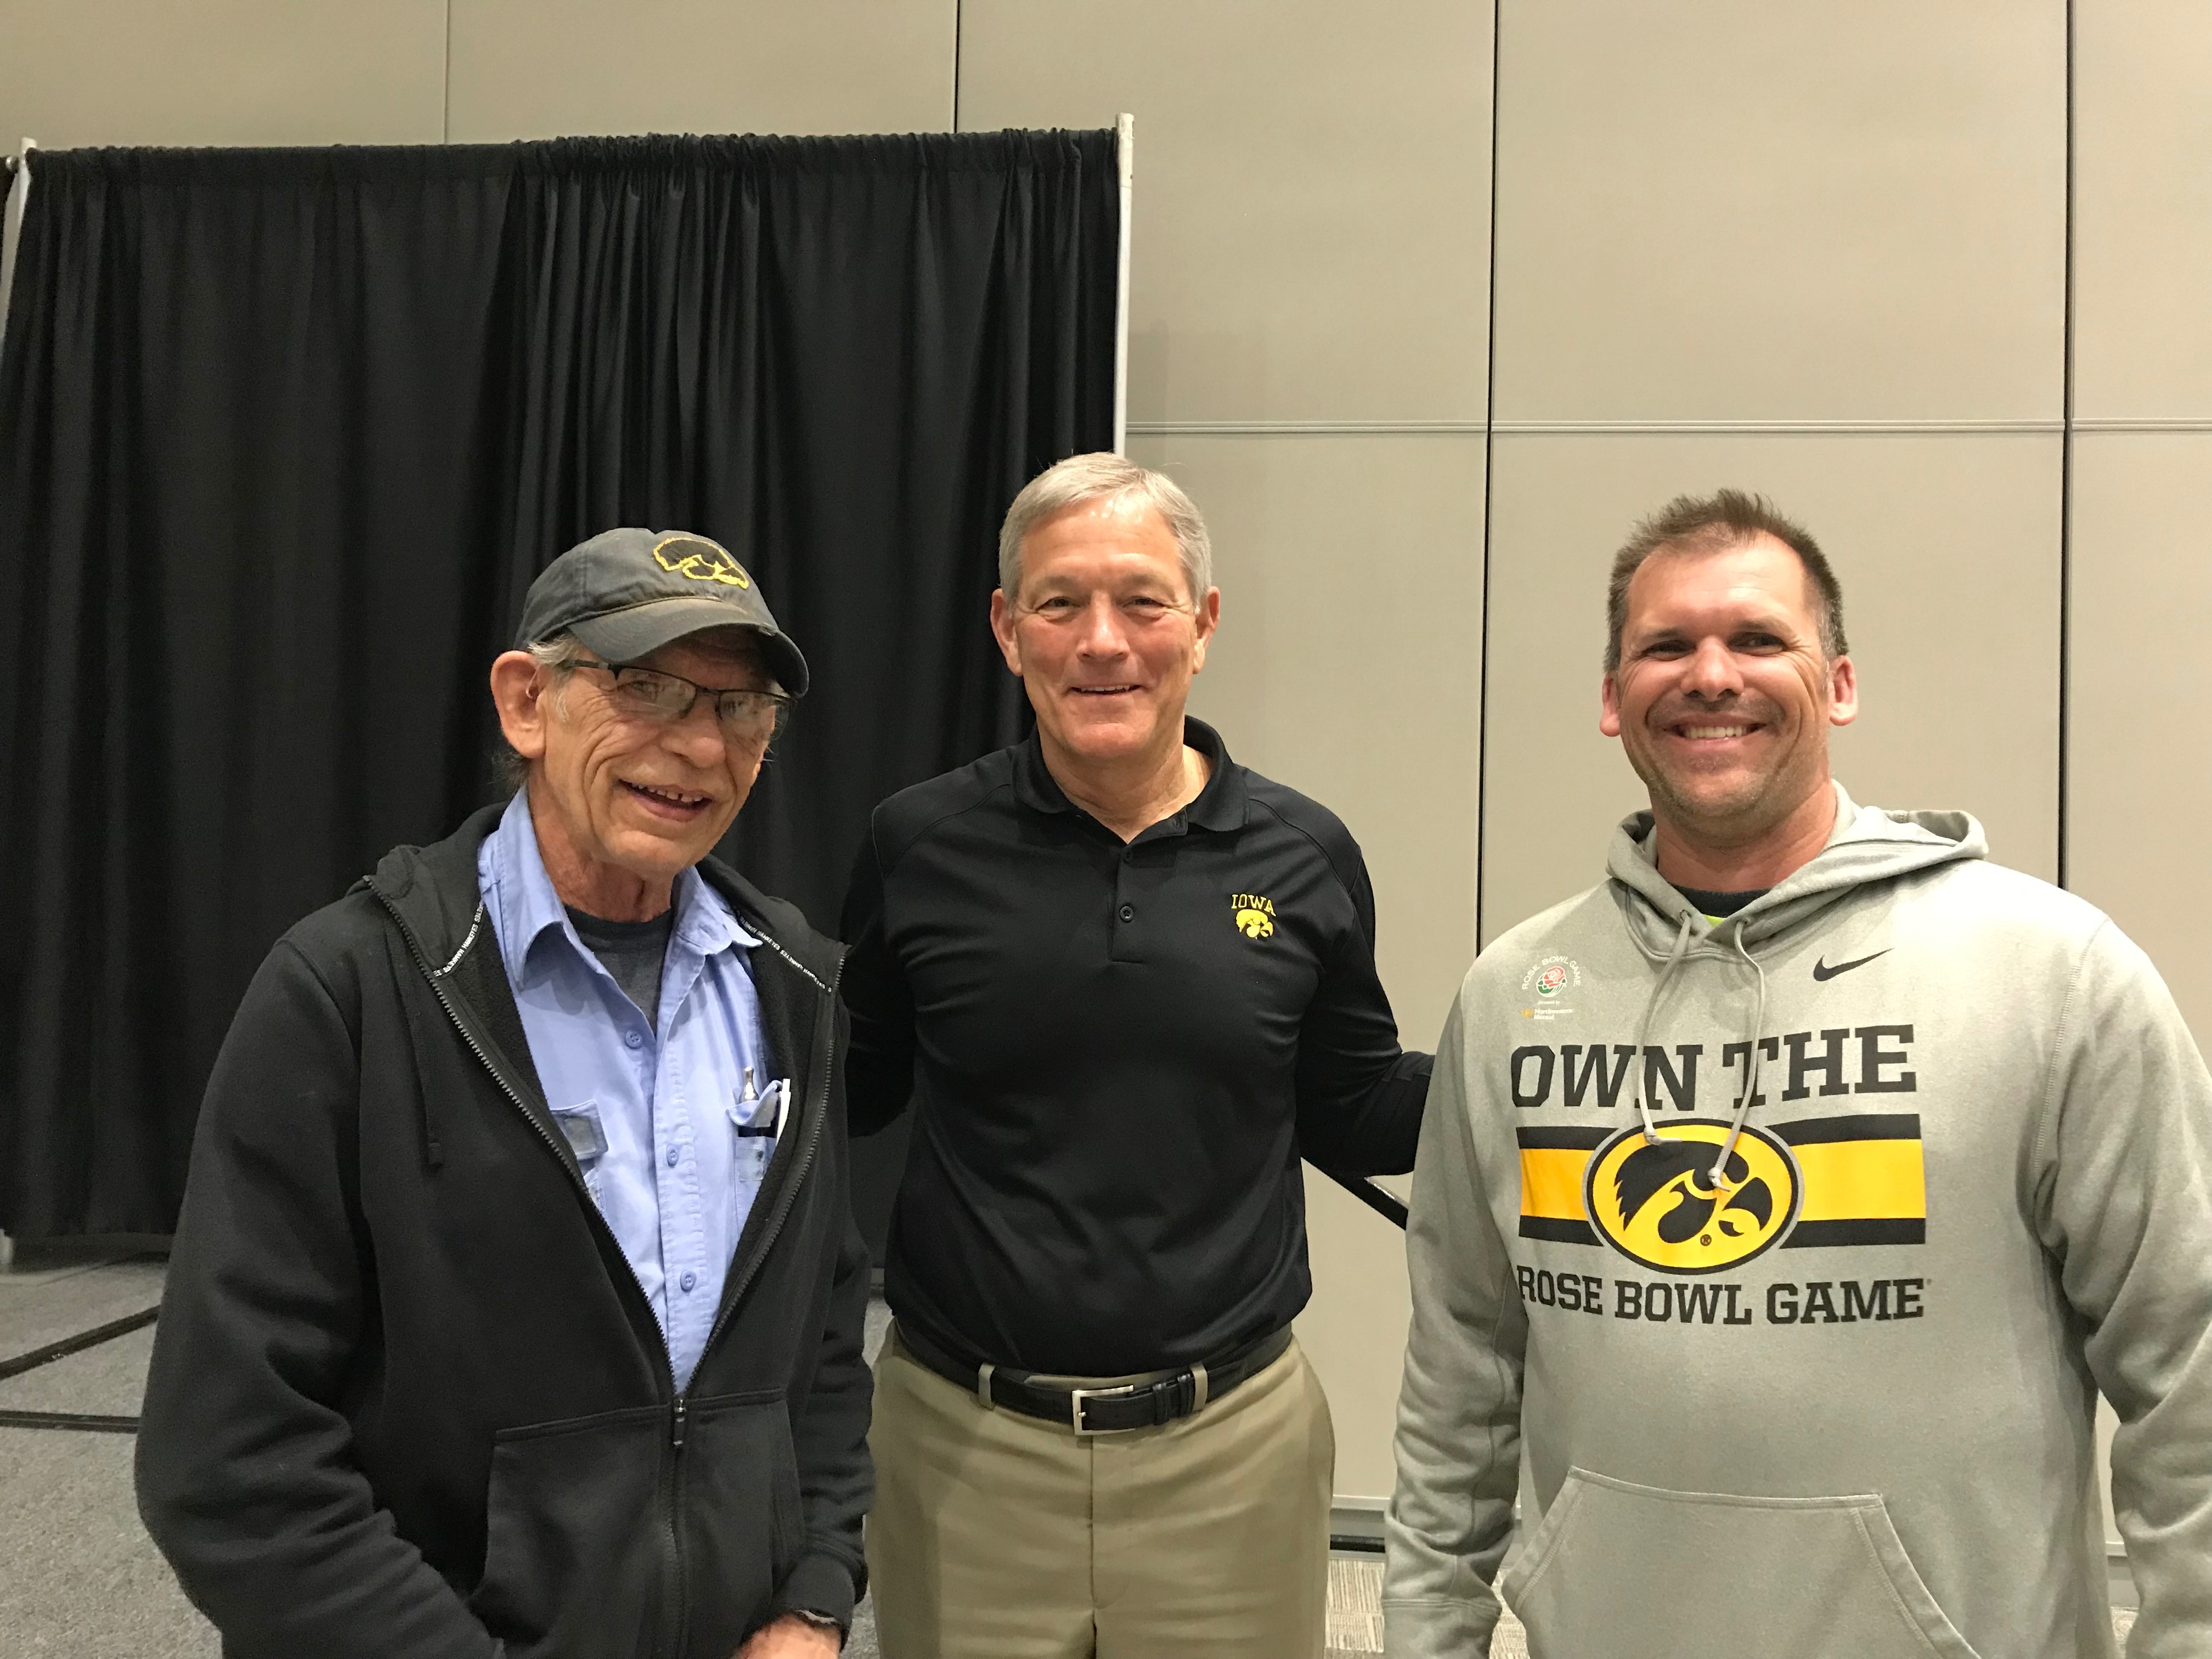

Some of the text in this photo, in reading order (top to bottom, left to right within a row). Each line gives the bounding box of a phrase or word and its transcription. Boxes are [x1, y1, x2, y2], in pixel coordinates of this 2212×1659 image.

[1231, 894, 1277, 917] IOWA
[1522, 956, 1581, 990] ROSE BOWL GAME
[1511, 1024, 1917, 1111] OWN THE
[1517, 1265, 1924, 1325] ROSE BOWL GAME
